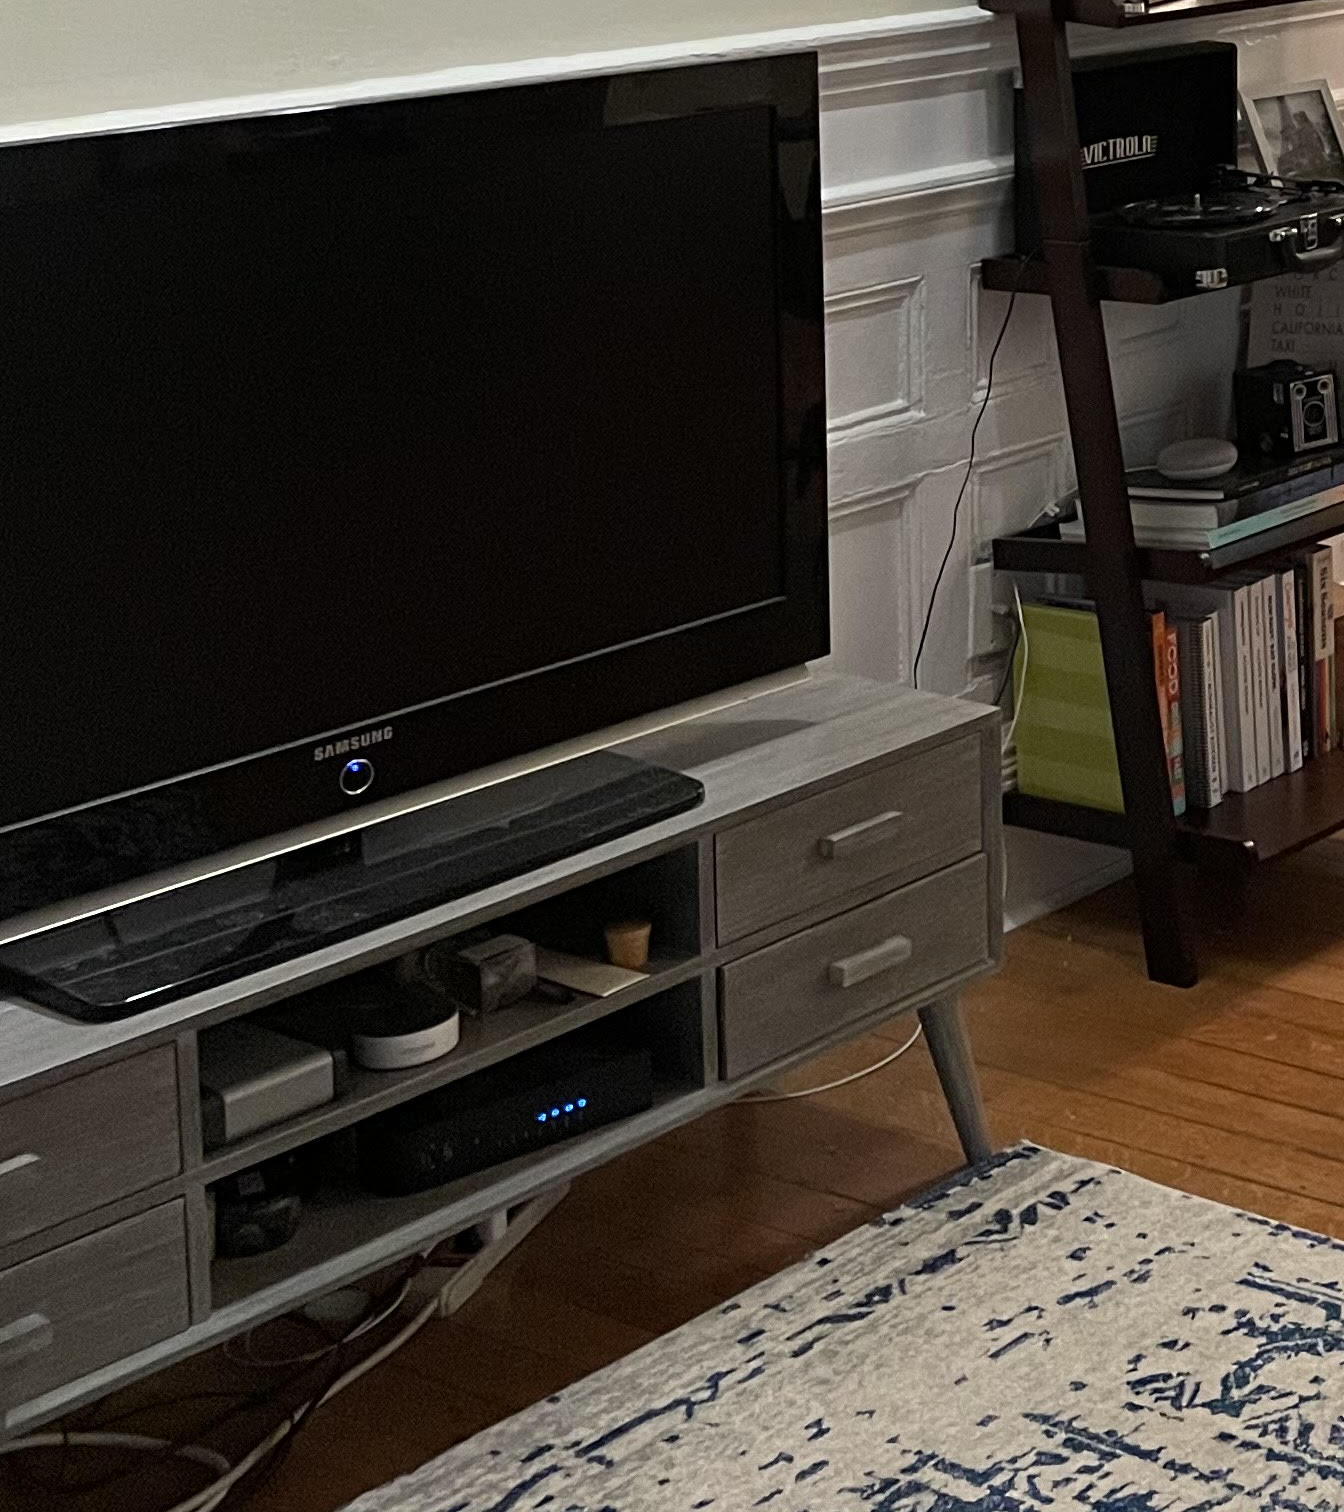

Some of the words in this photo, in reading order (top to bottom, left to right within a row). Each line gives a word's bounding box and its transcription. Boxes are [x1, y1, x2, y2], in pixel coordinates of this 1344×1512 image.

[1083, 135, 1152, 164] VICTROLA
[1167, 632, 1179, 696] FOOD
[313, 726, 394, 762] SAMSUNG
